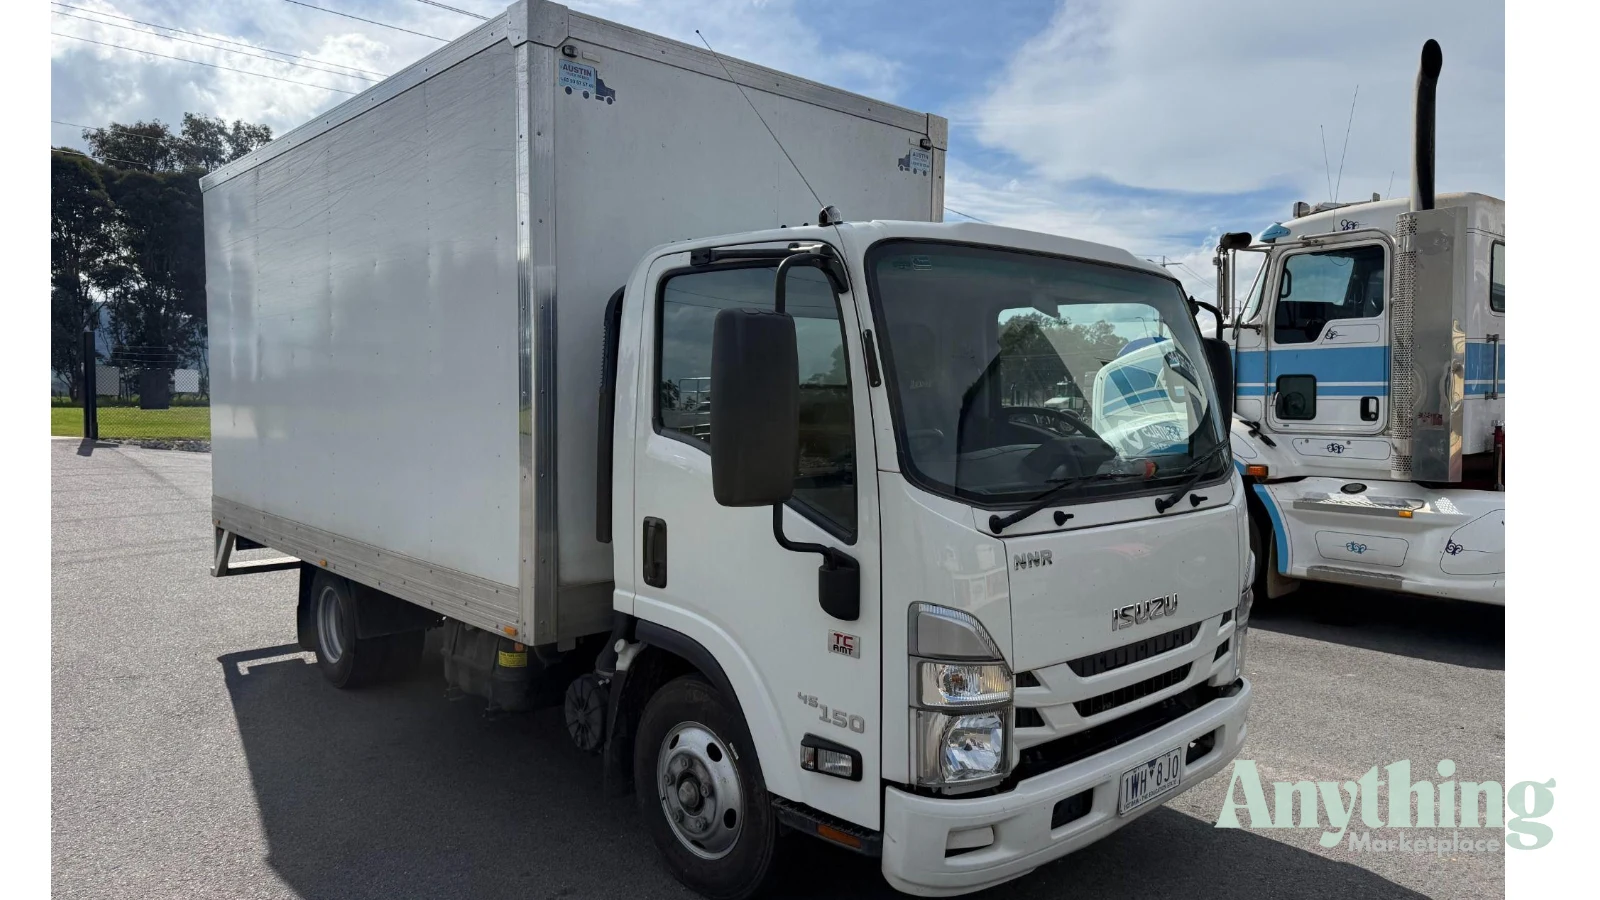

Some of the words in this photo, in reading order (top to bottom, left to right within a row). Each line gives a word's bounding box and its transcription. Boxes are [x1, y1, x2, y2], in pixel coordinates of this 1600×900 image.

[562, 64, 592, 77] AUSTIN
[1013, 549, 1053, 571] NNR
[1111, 593, 1179, 632] ISUZU
[832, 644, 853, 656] AMT
[833, 632, 854, 649] TC
[818, 704, 865, 734] 150
